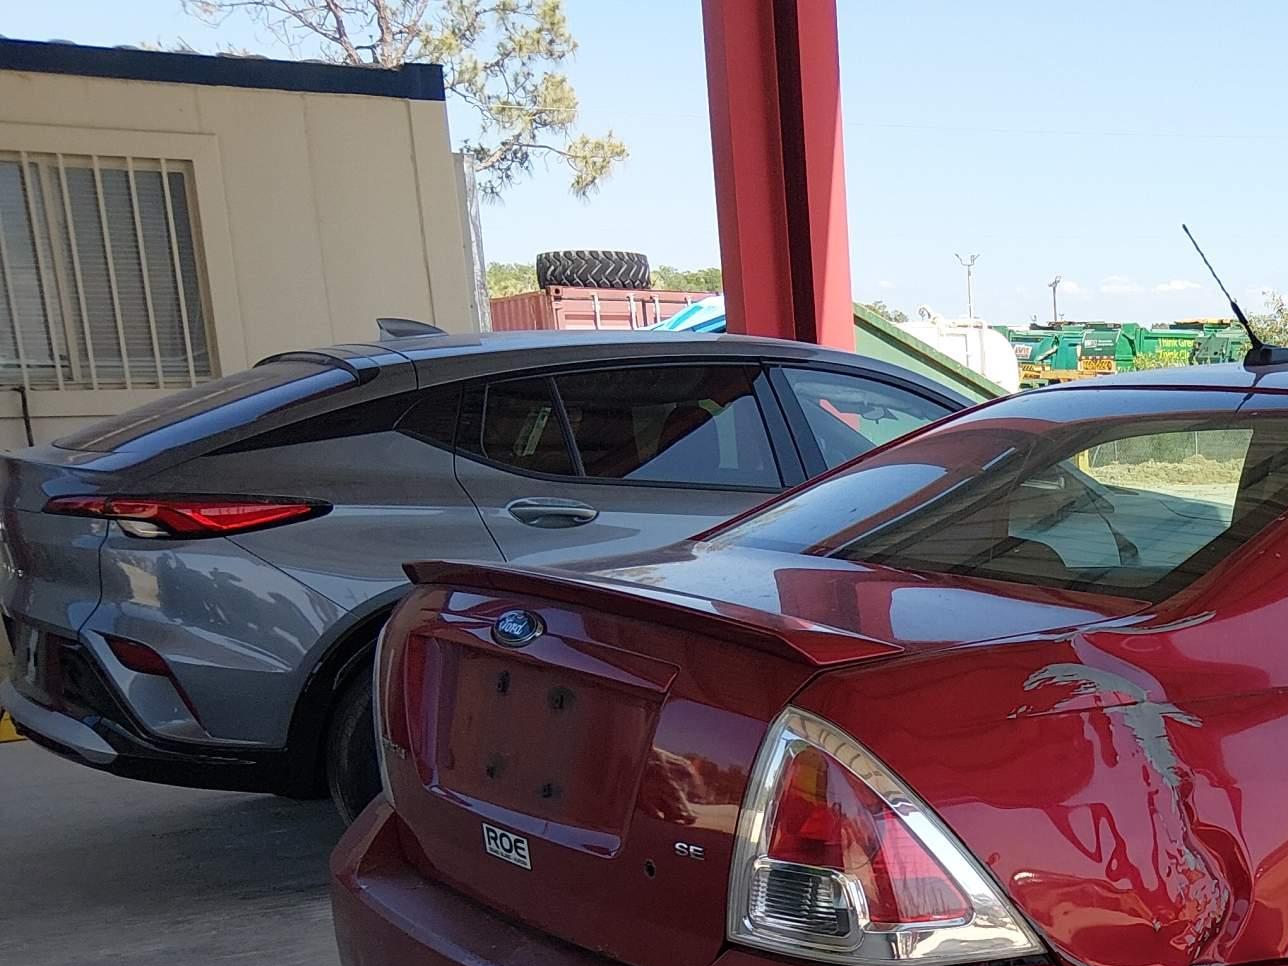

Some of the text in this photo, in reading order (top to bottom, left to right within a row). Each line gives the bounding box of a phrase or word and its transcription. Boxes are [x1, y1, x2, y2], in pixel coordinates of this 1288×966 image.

[499, 613, 528, 635] Ford
[485, 826, 527, 859] ROE
[674, 842, 705, 860] SE
